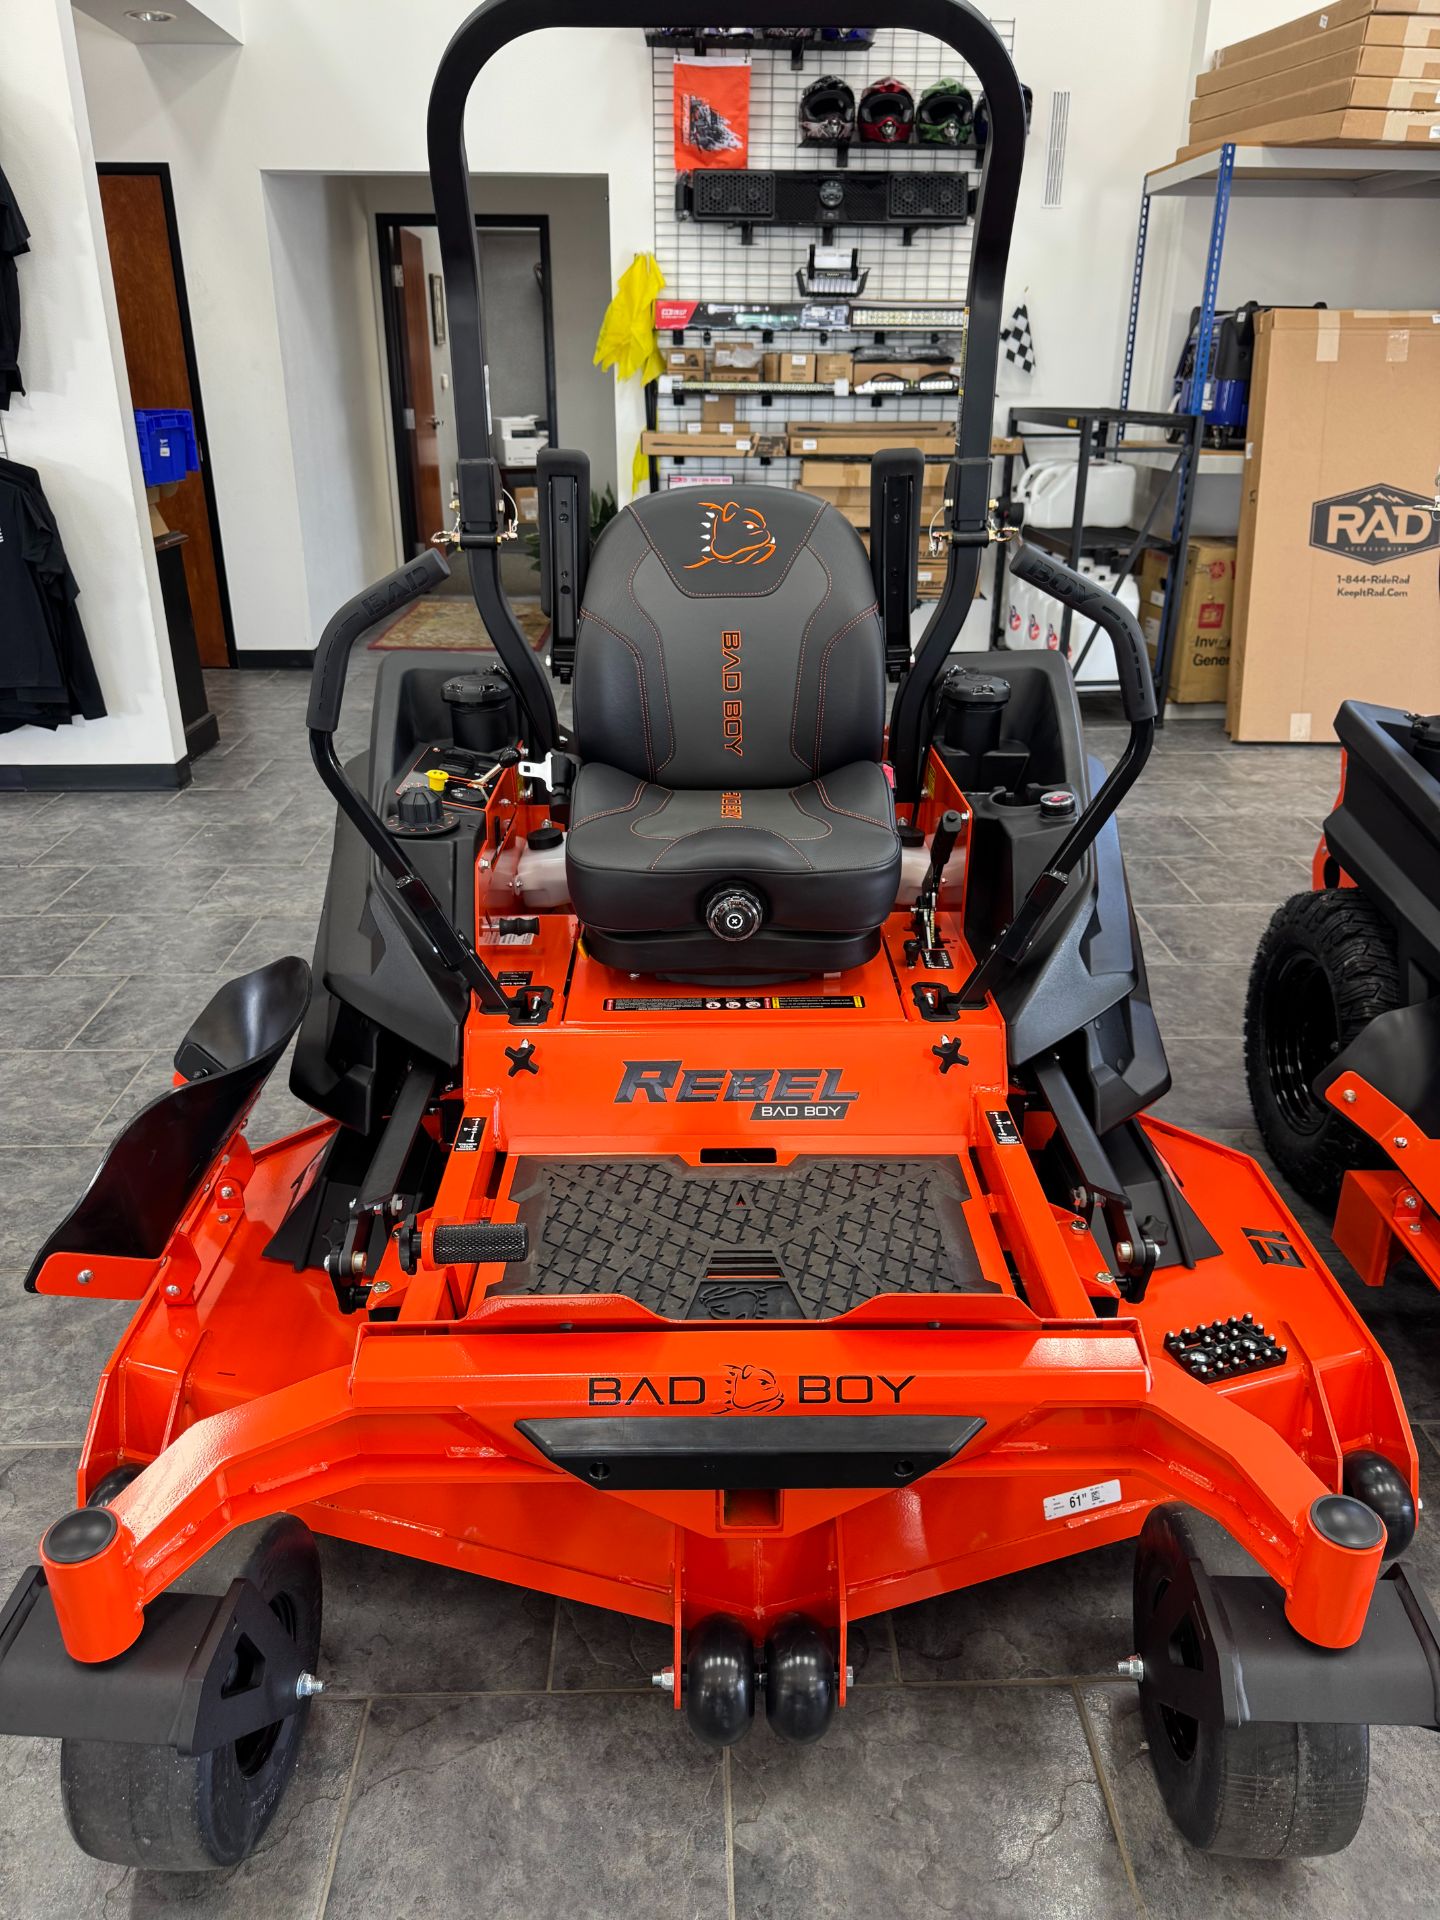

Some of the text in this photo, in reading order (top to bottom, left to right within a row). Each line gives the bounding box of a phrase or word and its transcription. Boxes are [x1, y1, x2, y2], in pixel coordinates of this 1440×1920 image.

[1326, 505, 1432, 544] RAD
[1337, 574, 1411, 585] 1-844-RideRad
[1337, 587, 1408, 599] KeepItRad.Com
[721, 630, 744, 757] BAD BOY
[613, 1060, 860, 1103] REBEL
[761, 1106, 841, 1117] BAD BOY
[588, 1375, 917, 1406] BAD BOY
